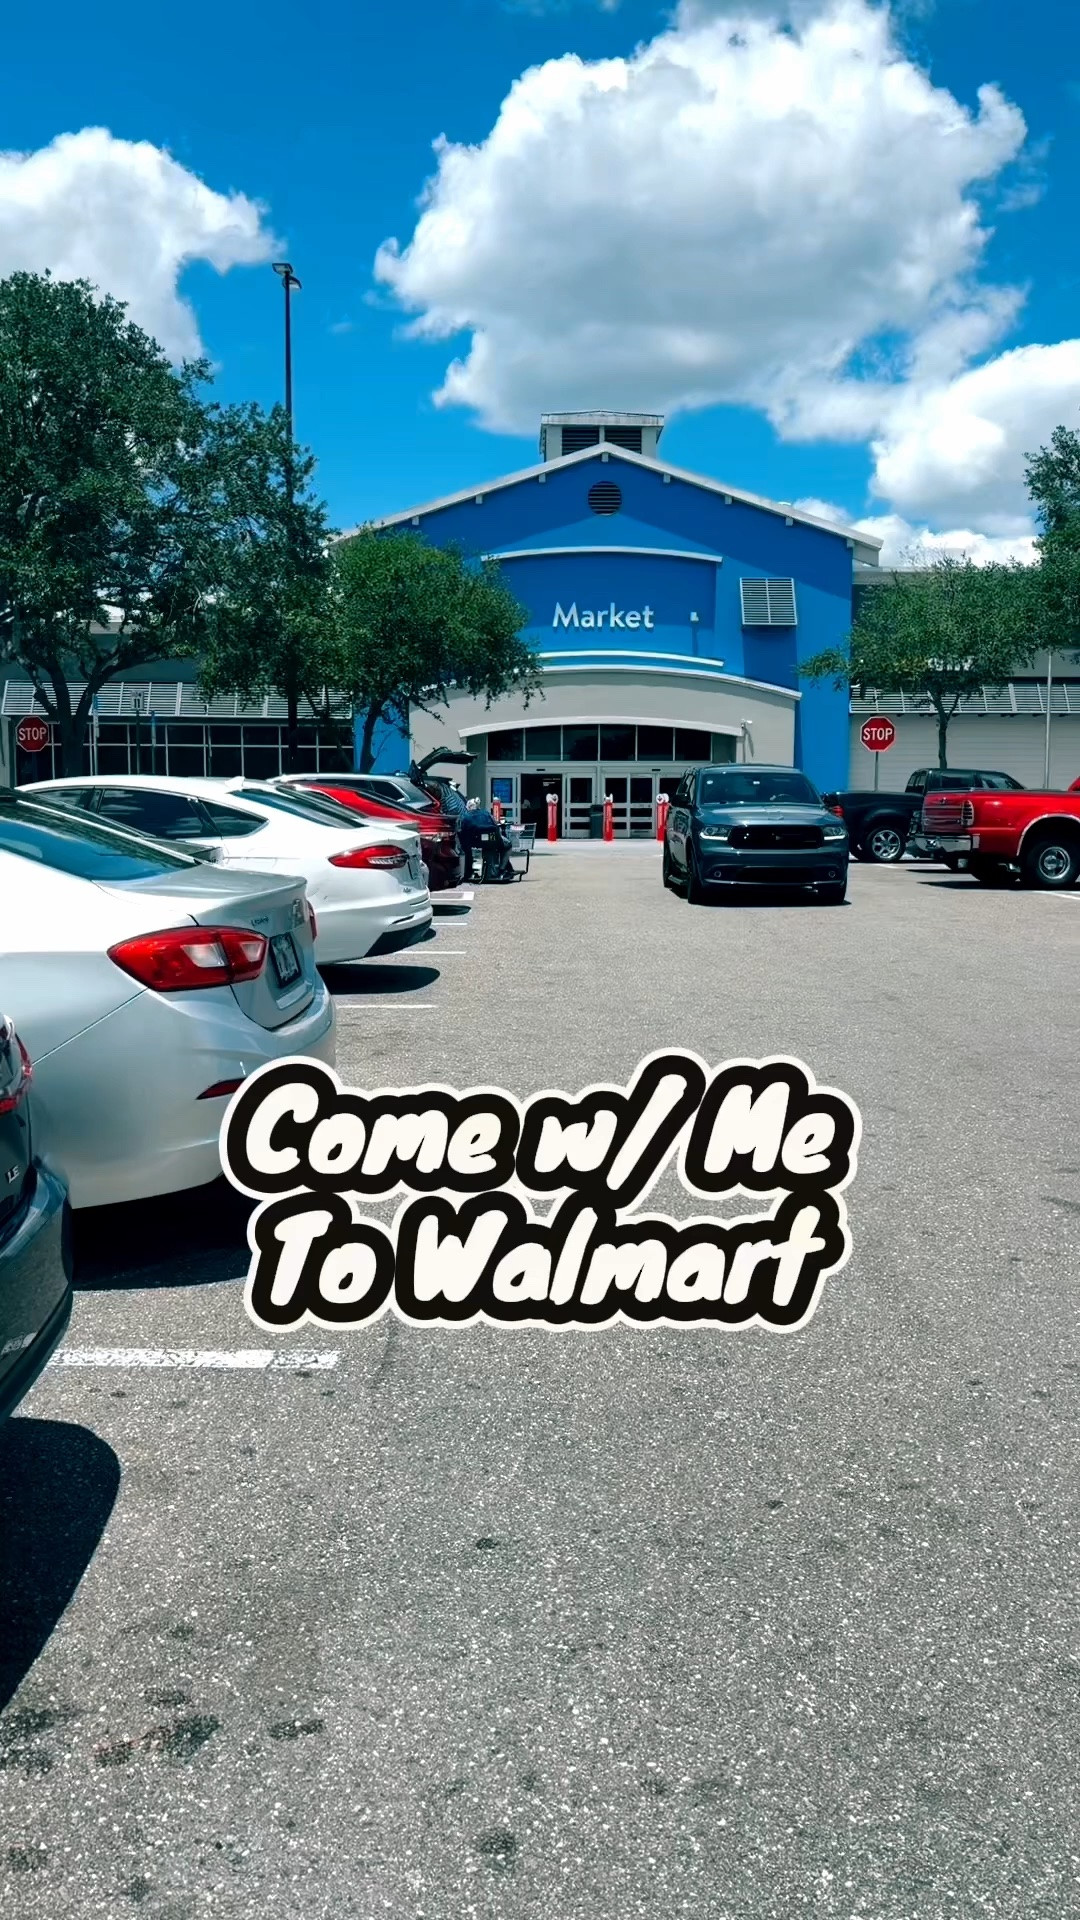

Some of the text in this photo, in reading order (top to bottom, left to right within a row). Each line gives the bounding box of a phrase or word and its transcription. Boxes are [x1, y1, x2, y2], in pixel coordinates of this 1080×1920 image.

[552, 601, 655, 629] Market
[18, 727, 47, 741] STOP
[863, 727, 893, 741] STOP
[7, 1165, 20, 1184] LE
